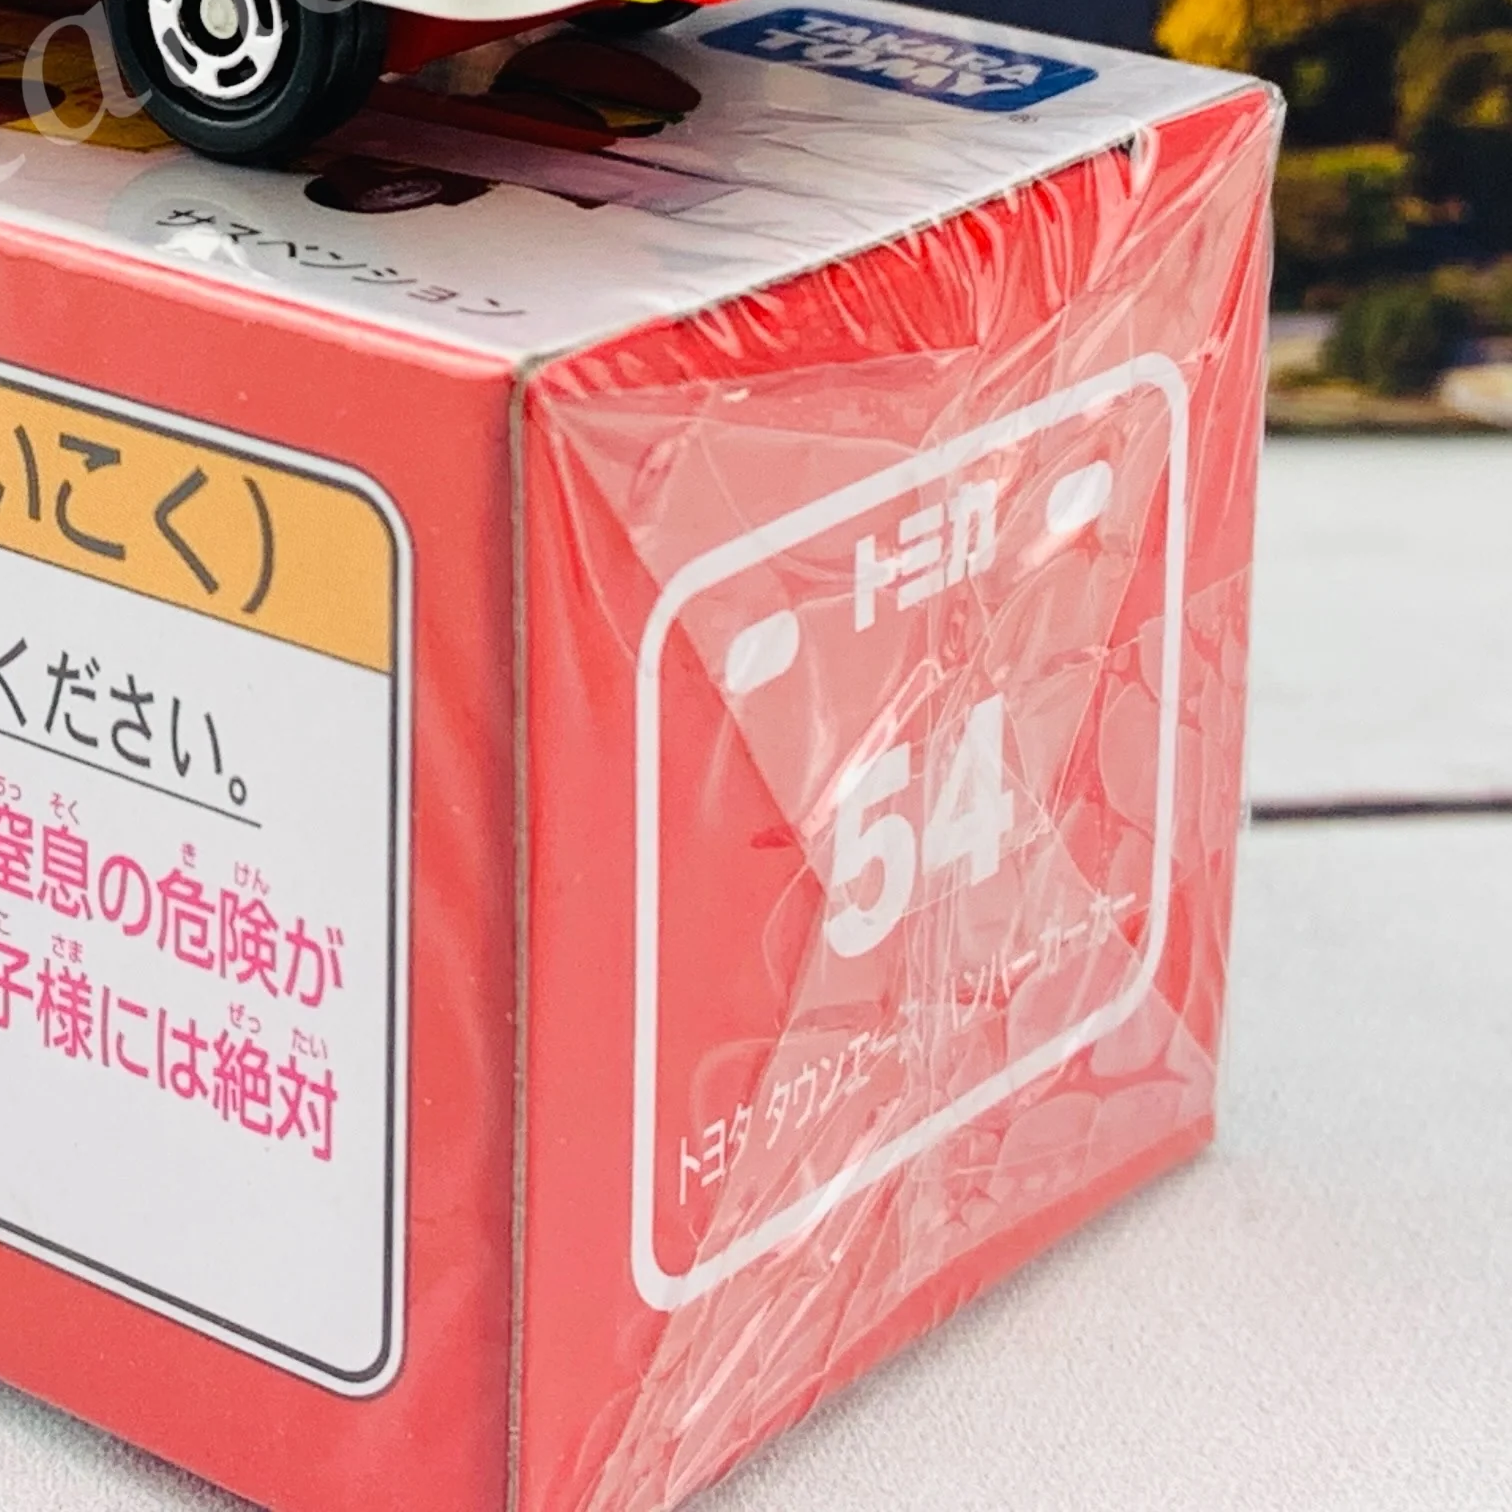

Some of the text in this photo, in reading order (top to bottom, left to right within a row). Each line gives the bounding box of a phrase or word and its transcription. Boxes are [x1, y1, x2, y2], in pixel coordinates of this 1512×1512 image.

[755, 28, 1025, 98] TOMY
[796, 15, 1041, 87] TAKARA
[156, 209, 526, 317] サスペンション
[855, 478, 998, 632] トミカ
[824, 692, 1015, 958] 54
[679, 1102, 754, 1206] トヨタ
